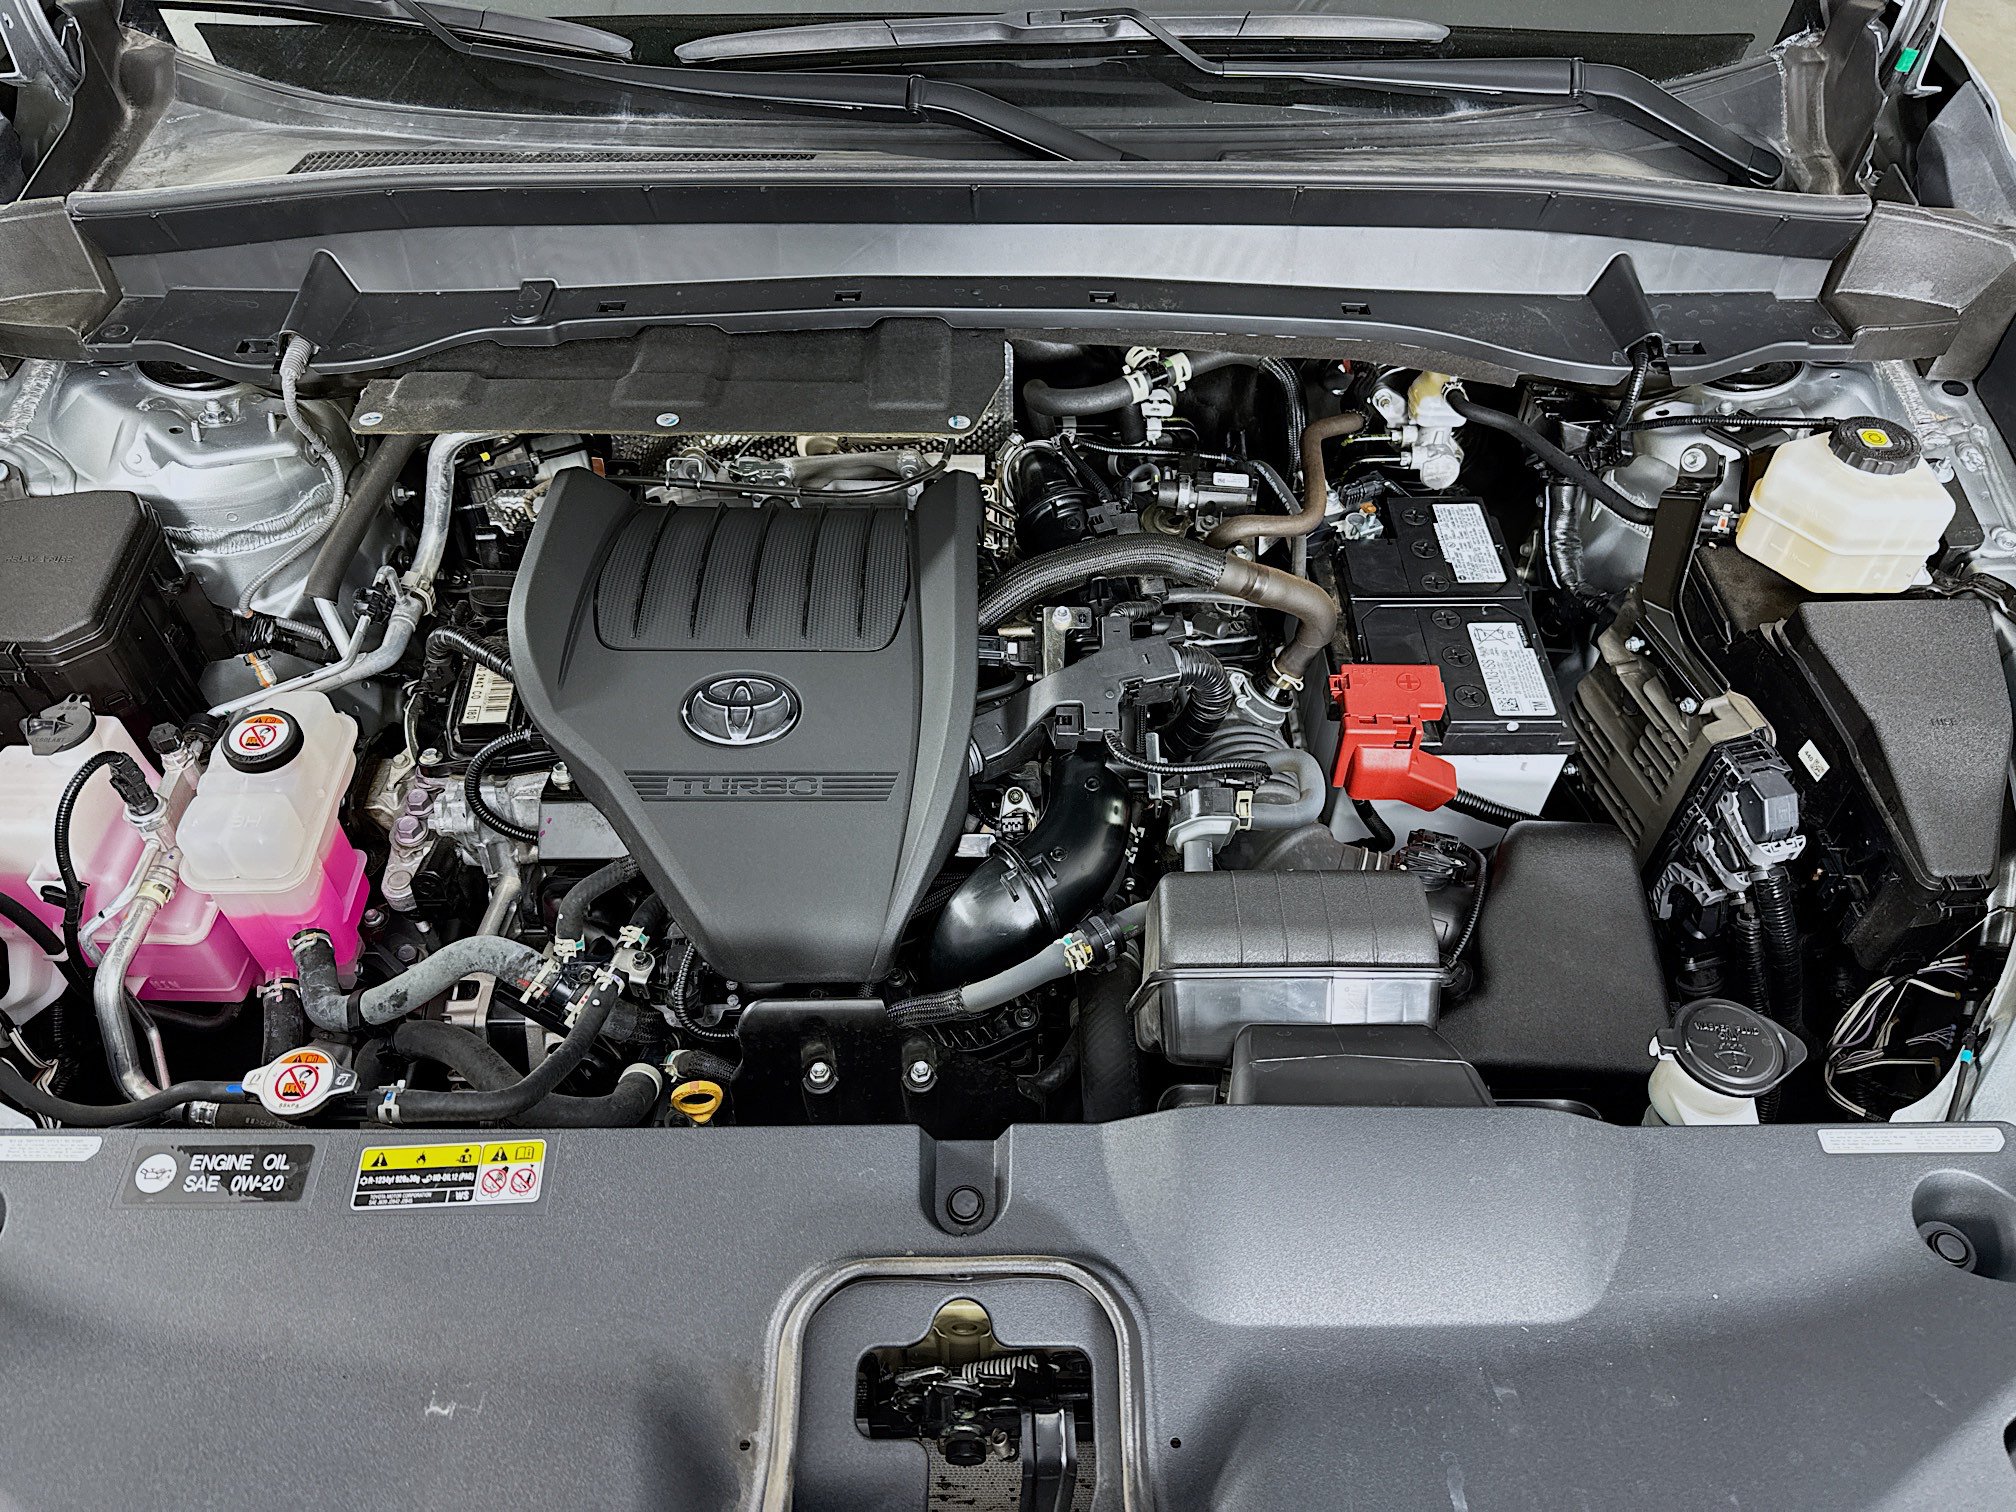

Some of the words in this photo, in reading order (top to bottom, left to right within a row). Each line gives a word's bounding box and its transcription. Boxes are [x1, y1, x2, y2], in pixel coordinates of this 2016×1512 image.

[672, 777, 819, 796] TURBO
[1694, 1021, 1731, 1033] WASHER
[1718, 1031, 1740, 1041] ONLY
[189, 1154, 254, 1172] ENGINE
[262, 1153, 291, 1171] OIL
[182, 1175, 221, 1193] SAE
[230, 1175, 285, 1192] 0W-20
[455, 1191, 470, 1201] WS
